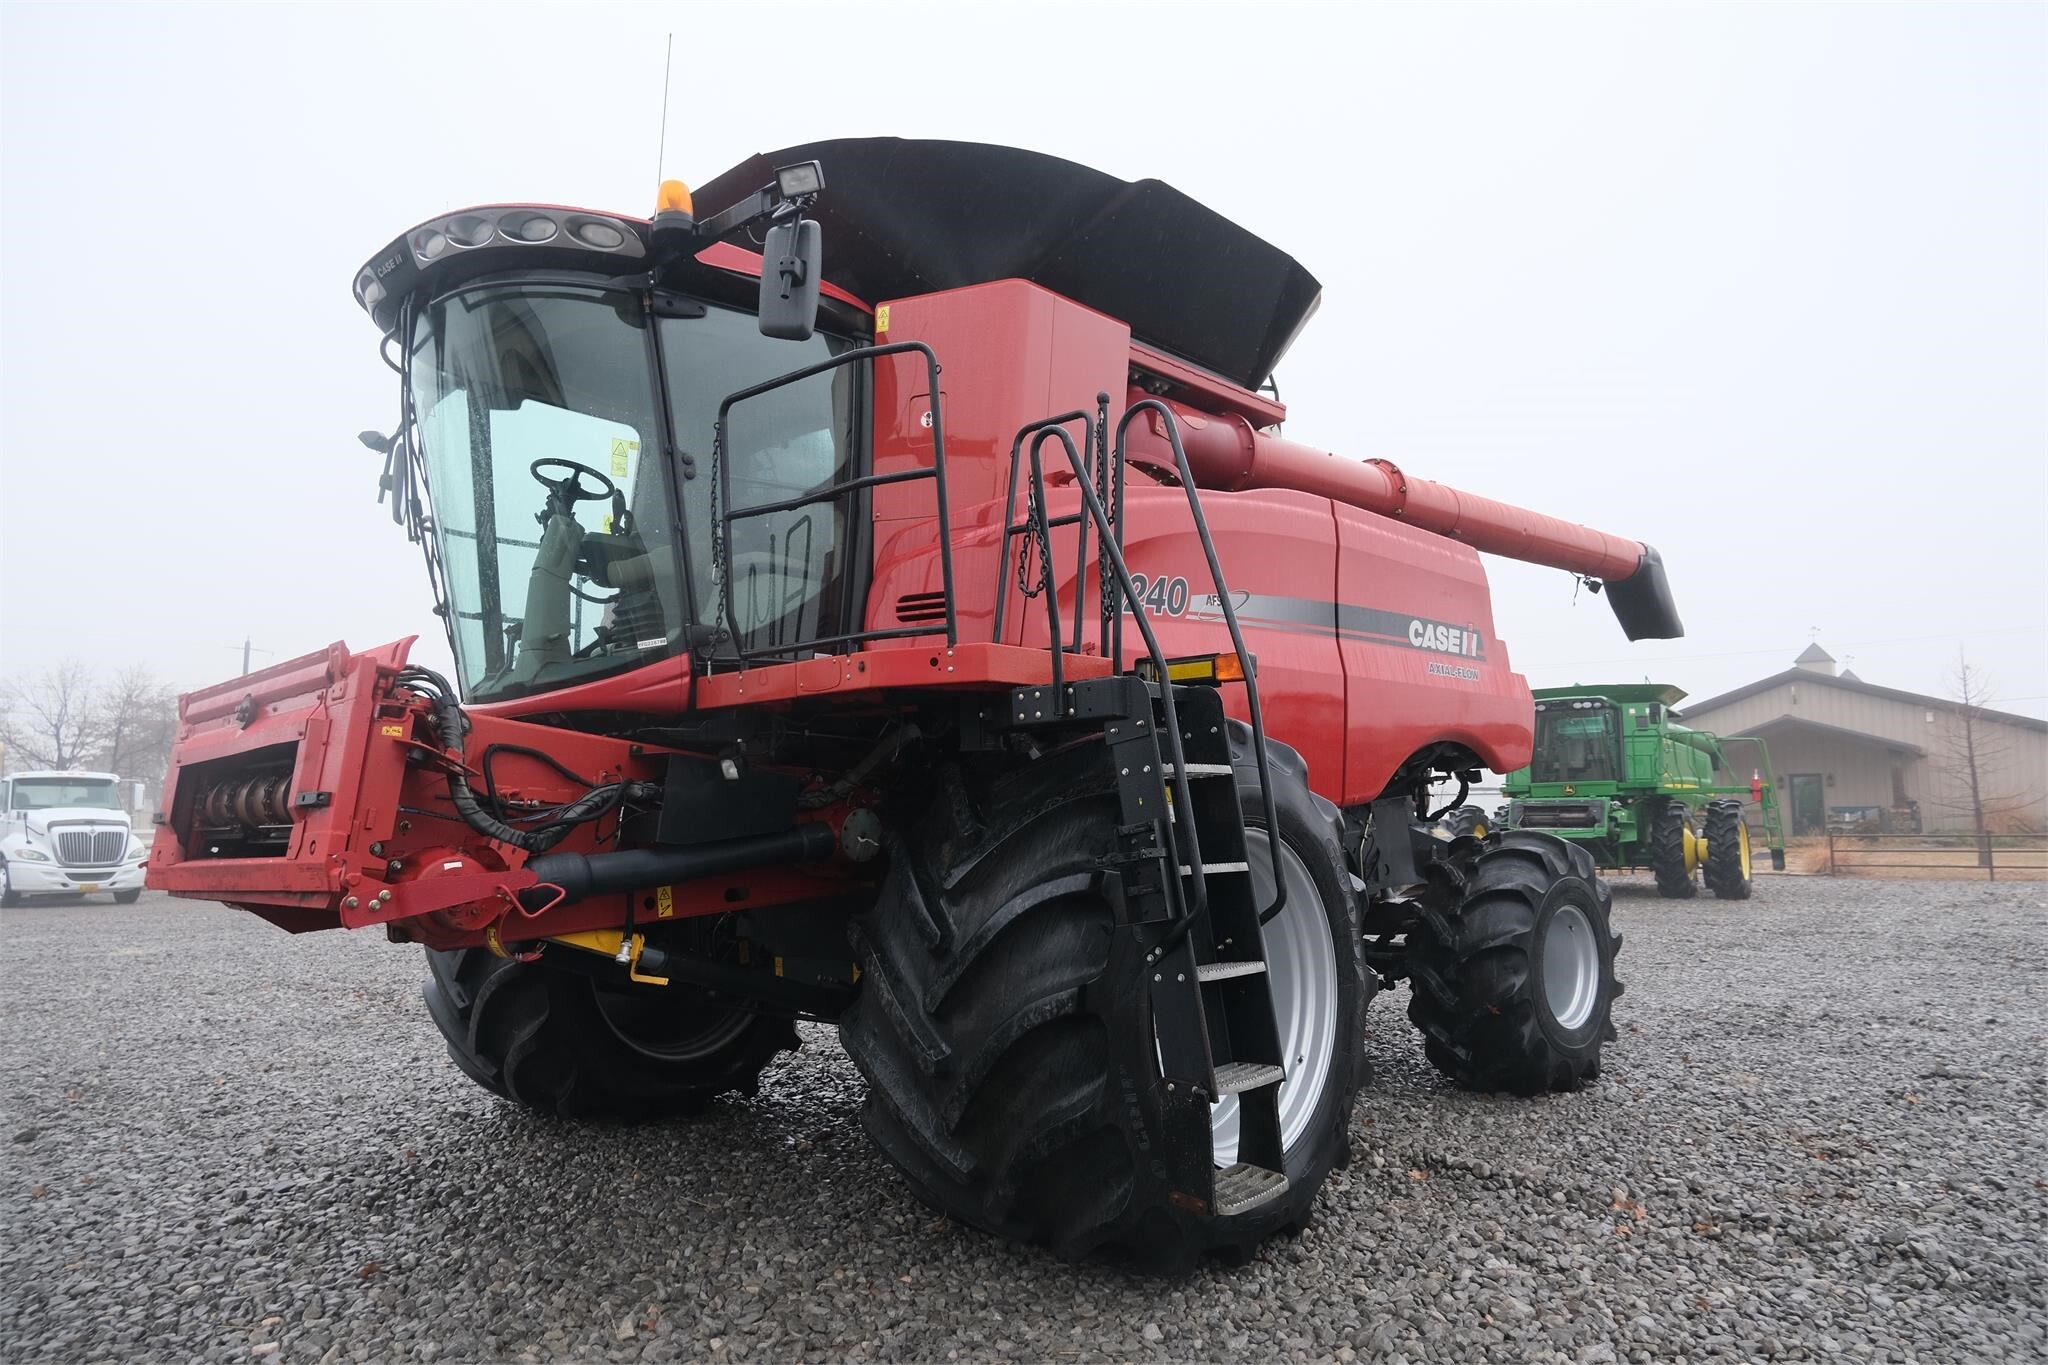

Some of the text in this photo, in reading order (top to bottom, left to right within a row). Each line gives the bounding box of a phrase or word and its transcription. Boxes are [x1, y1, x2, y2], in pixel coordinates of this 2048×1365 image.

[377, 258, 396, 278] CASE
[1121, 573, 1188, 617] 240
[1428, 663, 1480, 680] AXIAL-FLOW
